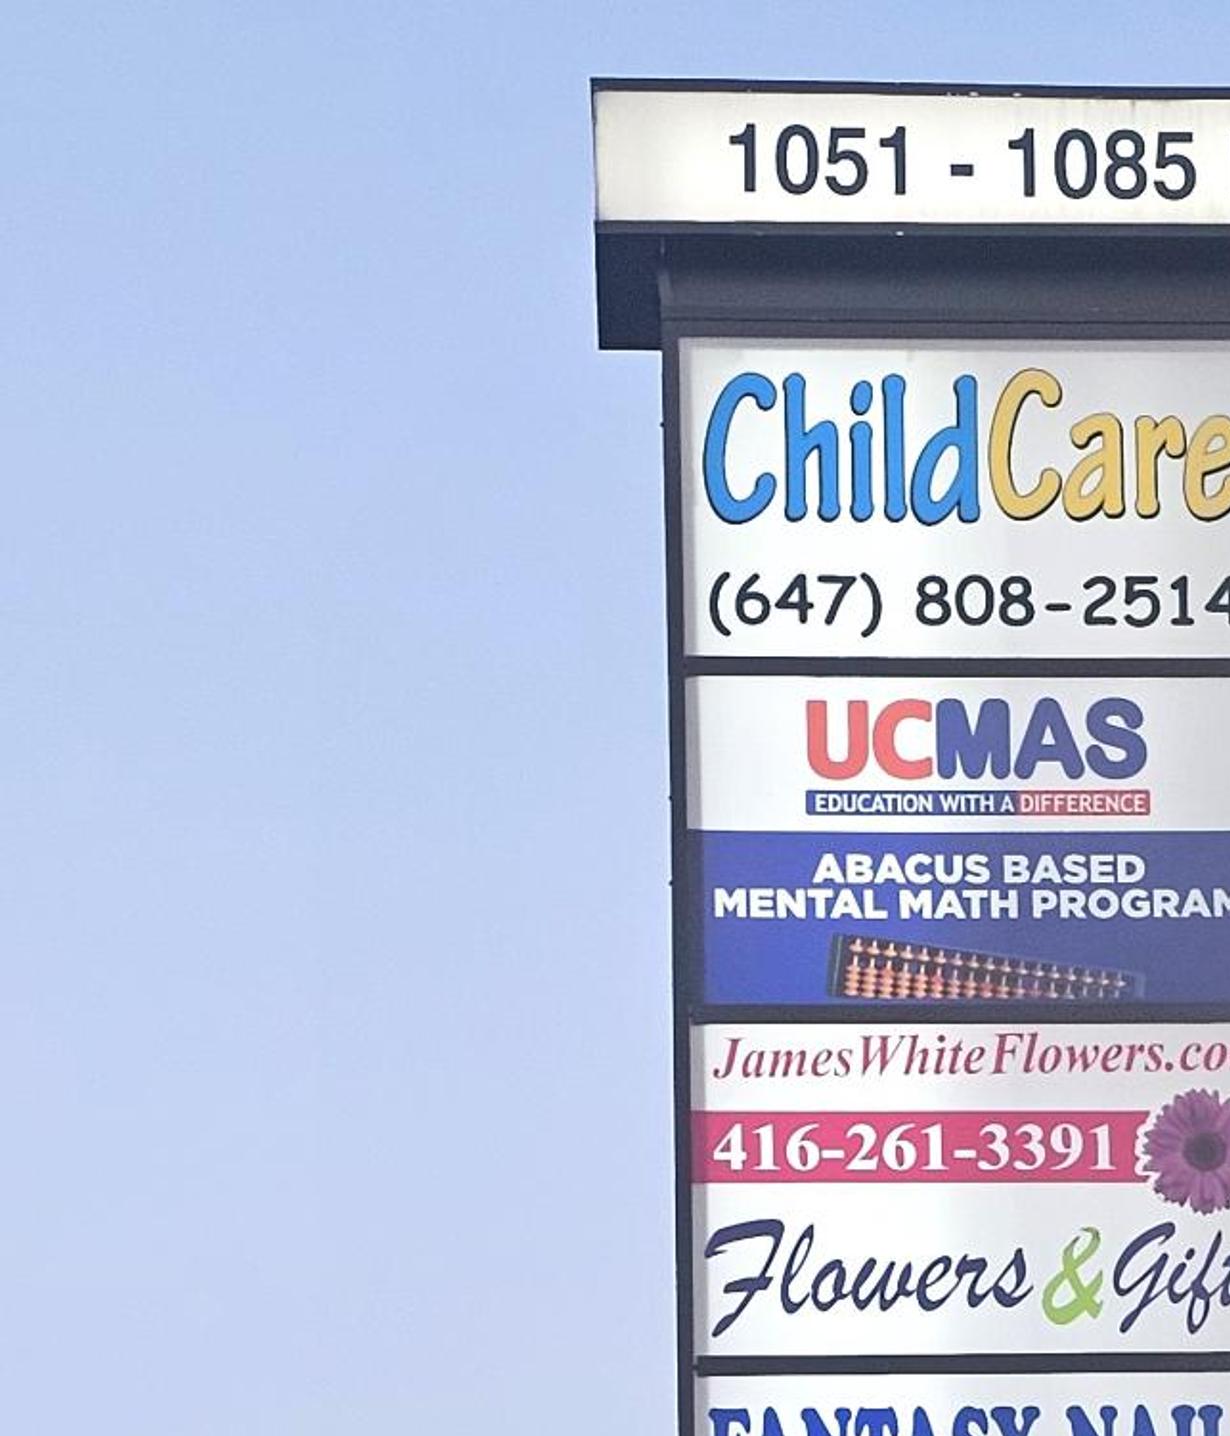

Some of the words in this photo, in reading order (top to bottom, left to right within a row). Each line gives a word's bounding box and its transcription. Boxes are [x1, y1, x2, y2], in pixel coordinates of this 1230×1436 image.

[729, 124, 912, 197] 1051
[949, 164, 975, 177] -
[1008, 130, 1197, 201] 1085
[708, 571, 885, 638] (647)
[806, 697, 1148, 780] UCMAS
[815, 793, 933, 813] EDUCATION
[939, 794, 995, 813] WITH
[1000, 794, 1015, 813] A
[1020, 792, 1147, 813] DIFFERENCE
[812, 852, 992, 885] ABACUS
[1003, 852, 1147, 884] BASED
[713, 889, 888, 919] MENTAL
[899, 888, 1020, 919] MATH
[712, 1121, 1118, 1172] 416-261-3391
[704, 1218, 1034, 1338] Flowers
[1042, 1225, 1104, 1326] &
